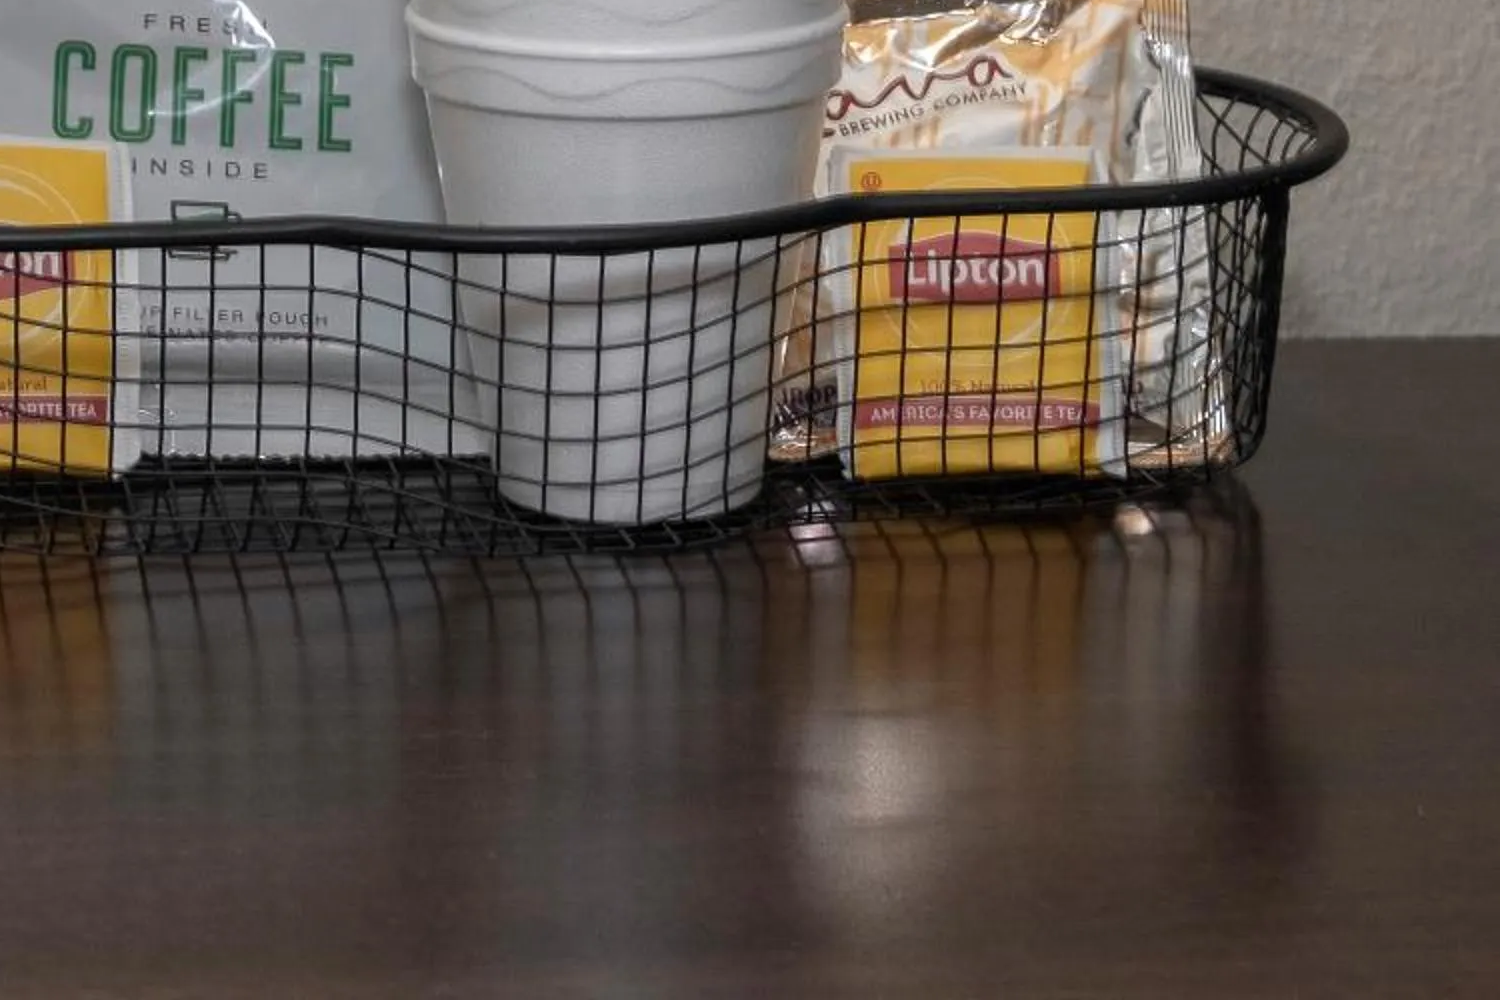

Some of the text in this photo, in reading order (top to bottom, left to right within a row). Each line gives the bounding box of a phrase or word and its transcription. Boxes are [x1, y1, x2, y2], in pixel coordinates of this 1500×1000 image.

[52, 40, 354, 152] COFFEE
[839, 81, 1027, 137] BREWING COMPANY
[131, 158, 269, 180] INSIDE
[903, 247, 1046, 294] Lipton
[172, 306, 244, 324] FILER
[69, 403, 96, 417] TEA
[871, 404, 1088, 421] AMRICAS FAORIE TEA
